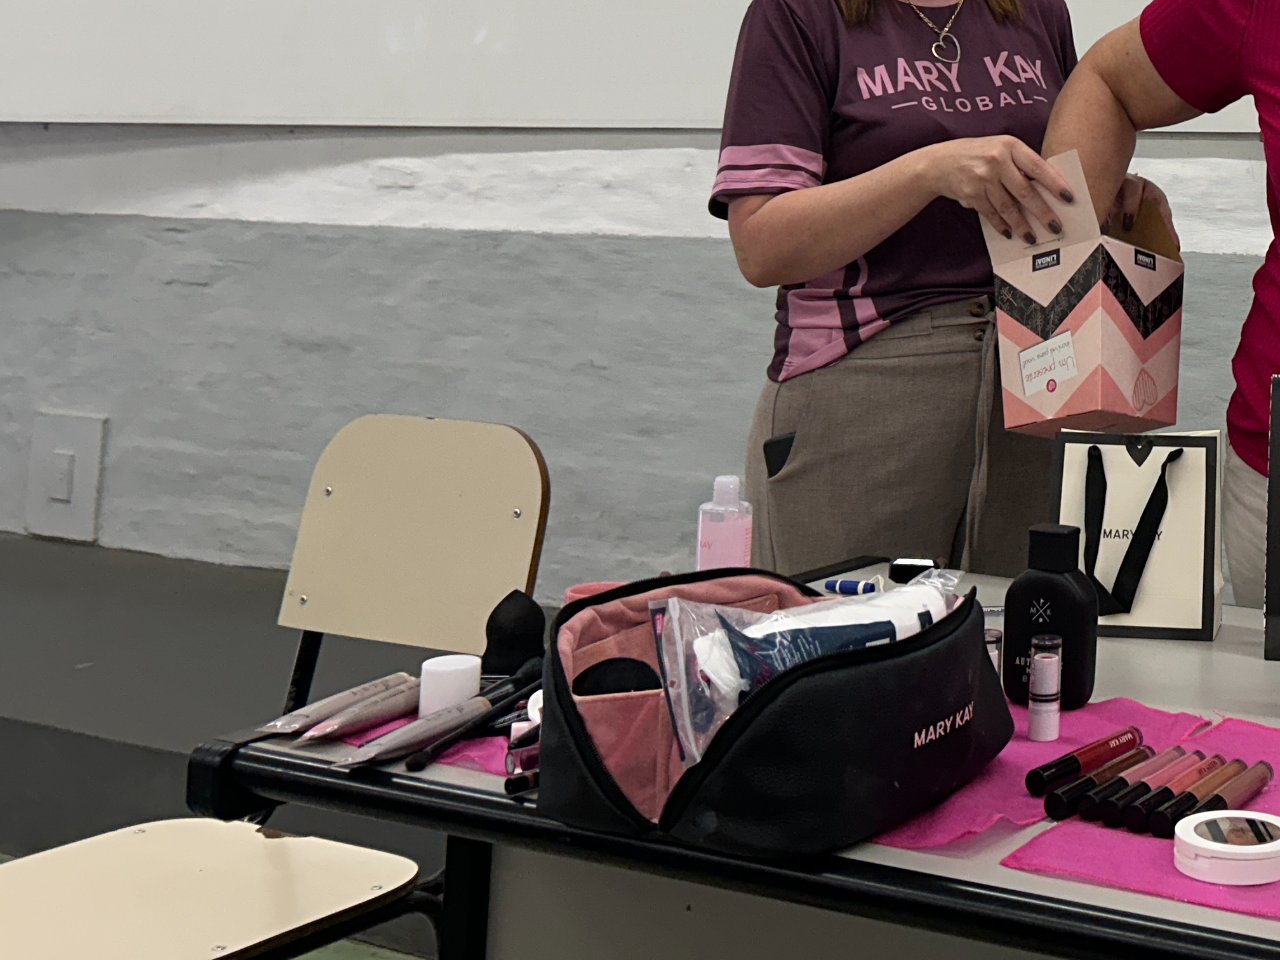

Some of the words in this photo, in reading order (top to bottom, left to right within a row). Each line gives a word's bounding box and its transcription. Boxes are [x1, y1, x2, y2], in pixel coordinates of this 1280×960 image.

[856, 57, 961, 100] MARY
[983, 50, 1048, 90] KAY
[921, 89, 1033, 113] GLOBAL
[914, 715, 953, 749] MARY
[955, 700, 974, 729] KAY
